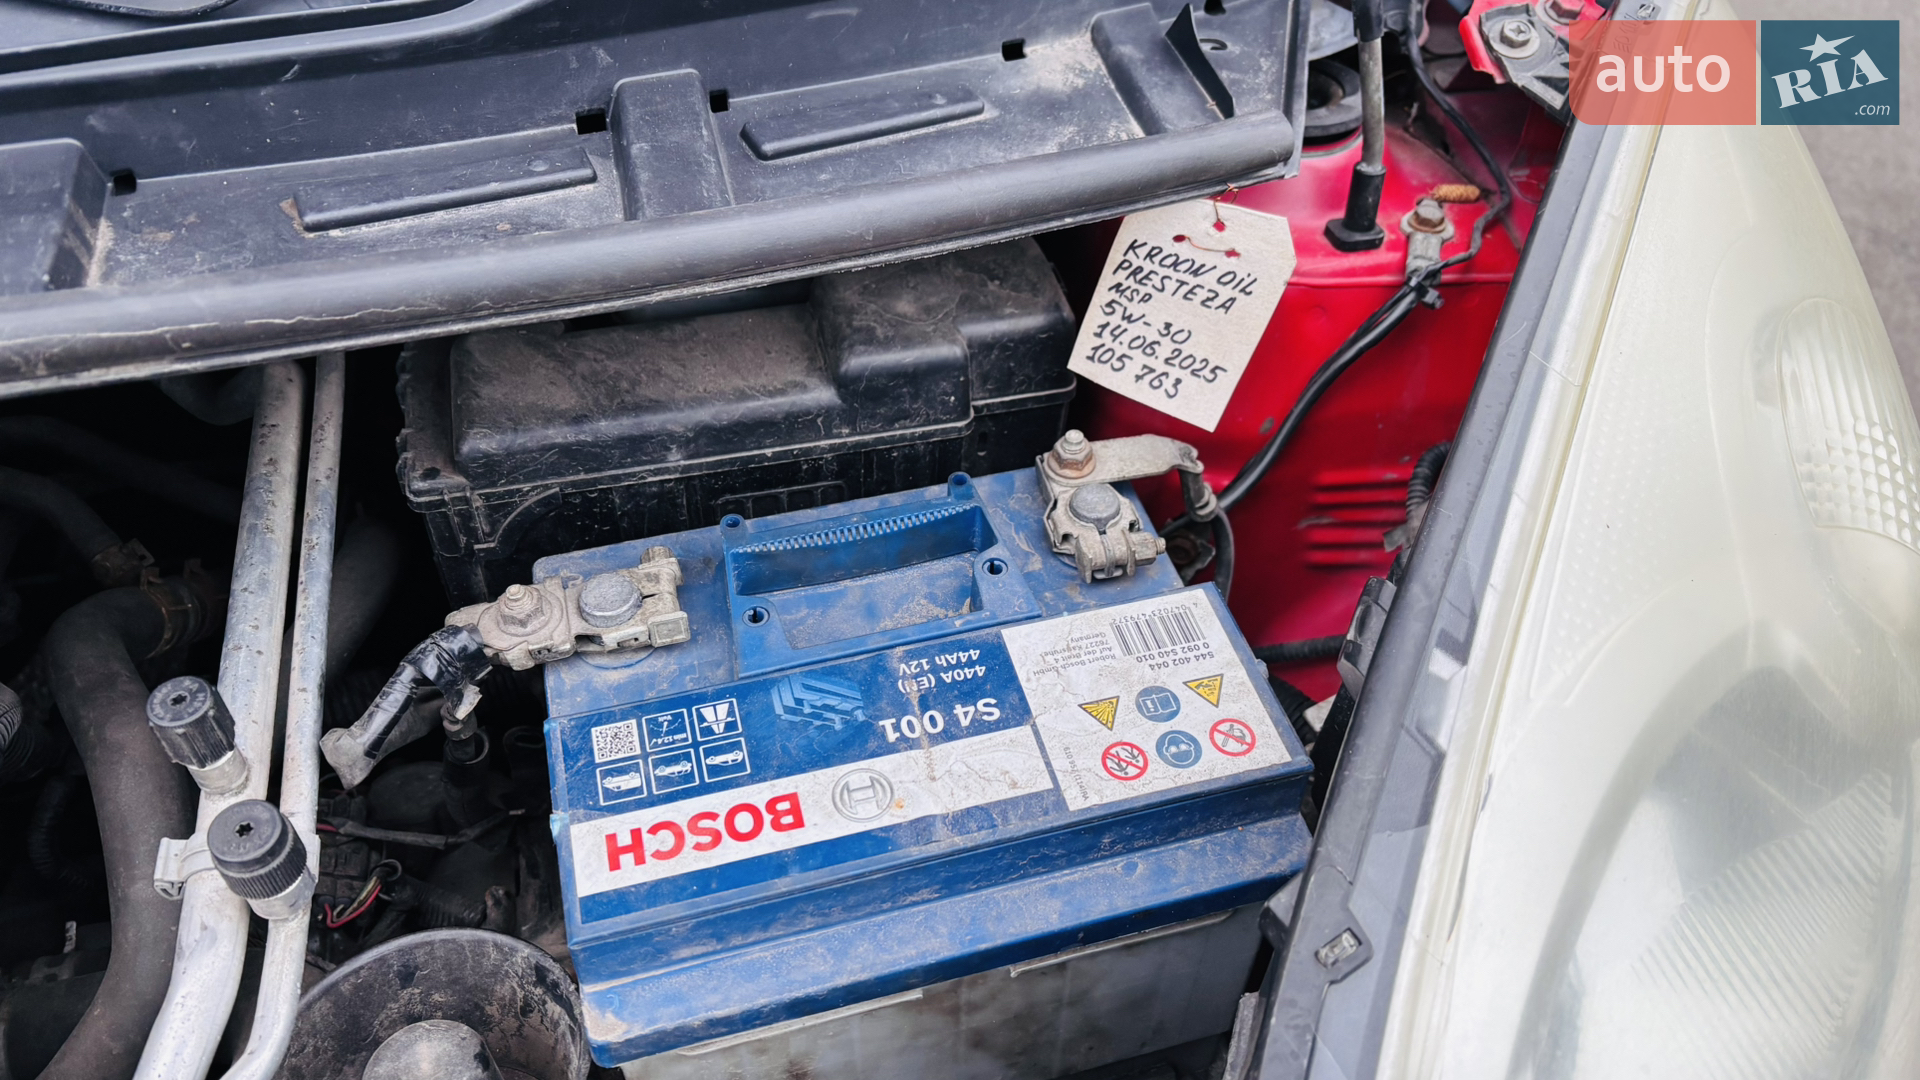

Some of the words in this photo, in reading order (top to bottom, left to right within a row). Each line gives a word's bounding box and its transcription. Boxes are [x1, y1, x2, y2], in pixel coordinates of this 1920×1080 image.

[1123, 239, 1217, 278] KROON
[1108, 282, 1152, 304] MSP
[1113, 258, 1237, 315] PRESTEZA
[1093, 321, 1228, 384] 14.06.2025
[1086, 343, 1133, 373] 105
[1134, 364, 1183, 399] 763
[1070, 631, 1105, 643] Germany
[1085, 639, 1109, 649] 76227
[934, 649, 980, 667] 44Ah
[1099, 645, 1112, 653] Auf
[1181, 645, 1200, 656] 092
[1194, 651, 1215, 662] 544
[899, 658, 930, 676] 12V
[1060, 659, 1085, 670] Bosch
[1088, 653, 1115, 664] Robert
[1135, 653, 1156, 664] 010
[1149, 660, 1170, 671] 044
[1173, 656, 1191, 667] 402
[940, 665, 986, 684] 440A
[953, 698, 1000, 727] S4
[879, 710, 944, 743] 001
[605, 792, 805, 872] BOSCH
